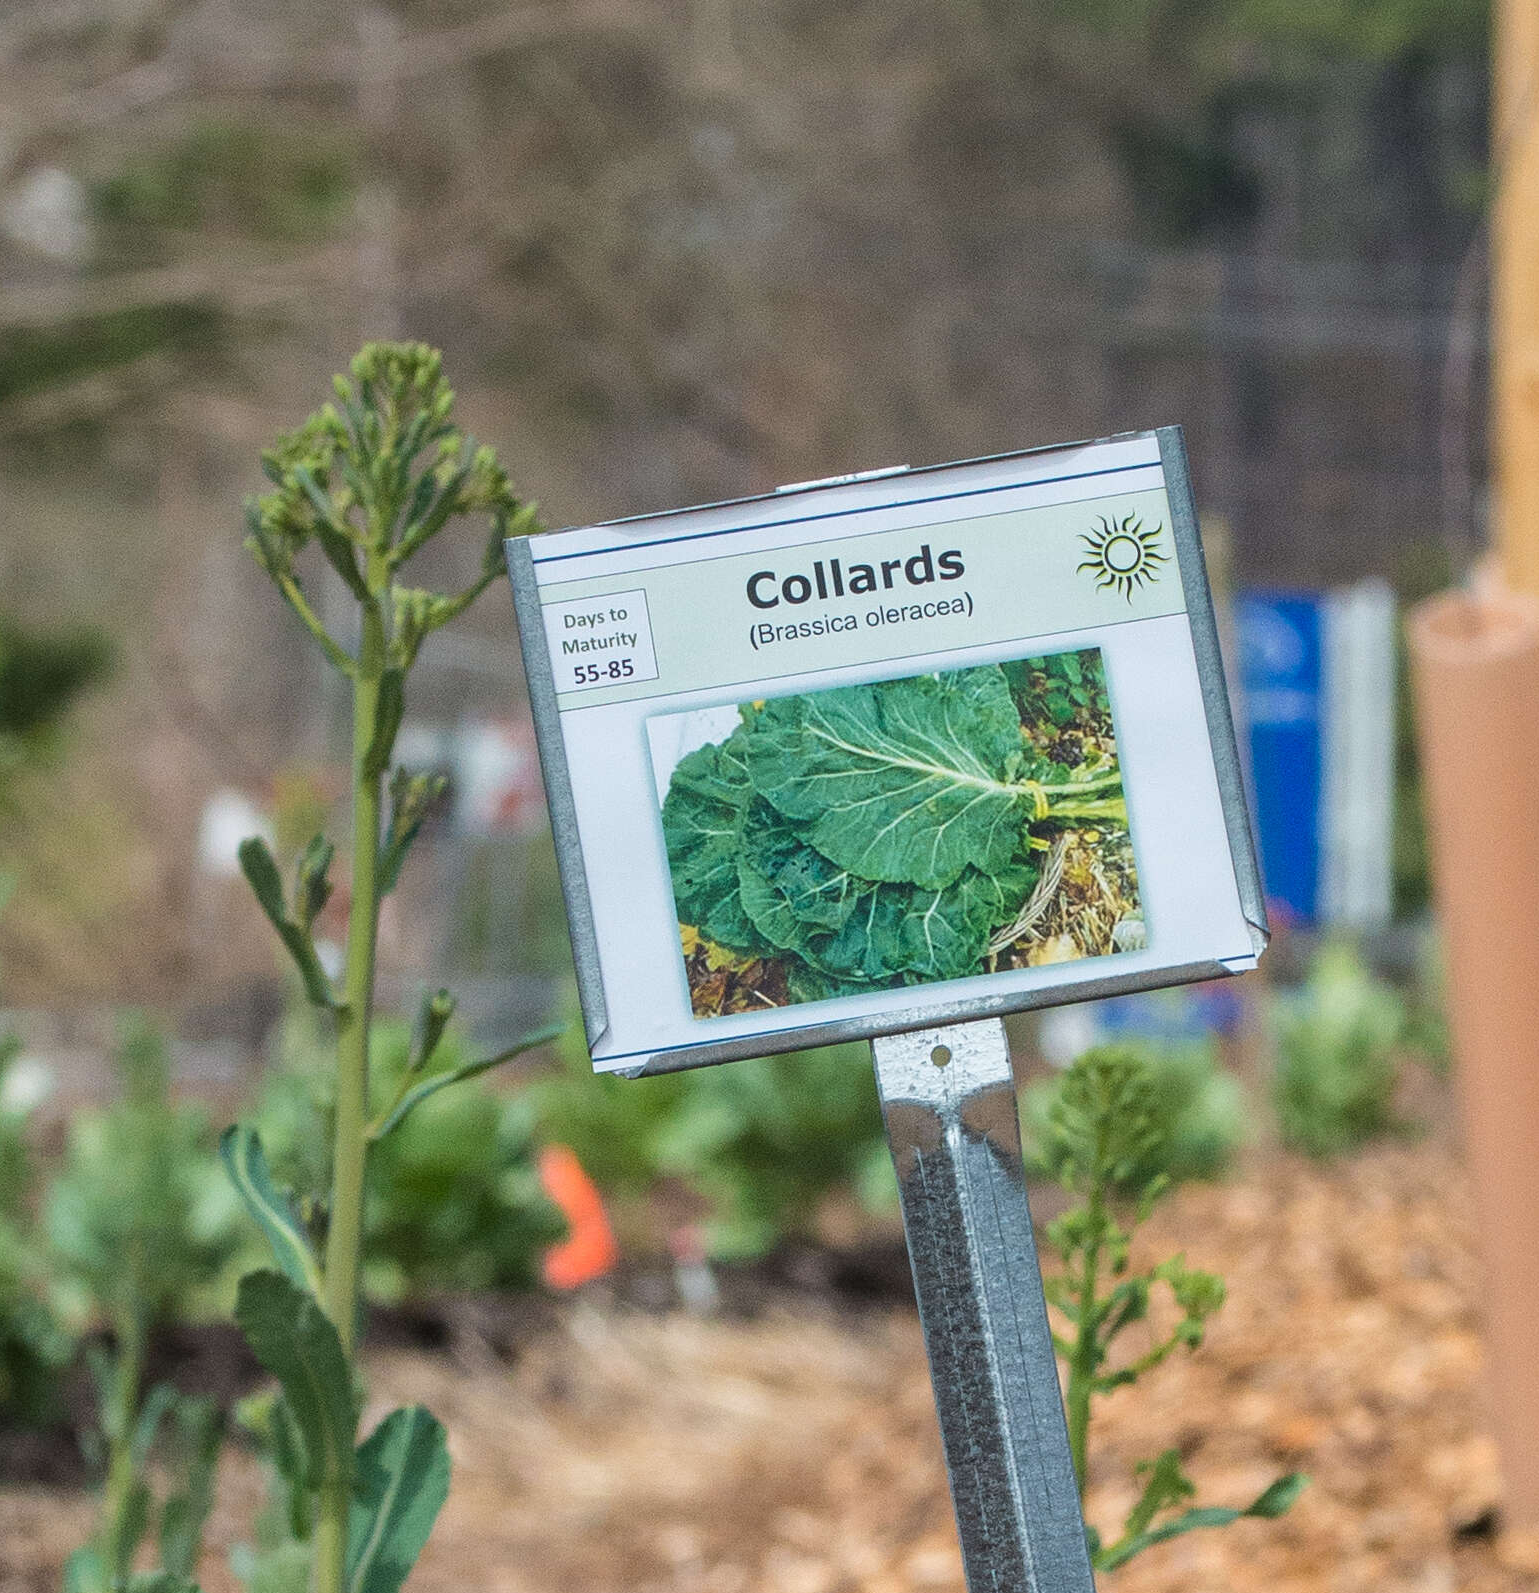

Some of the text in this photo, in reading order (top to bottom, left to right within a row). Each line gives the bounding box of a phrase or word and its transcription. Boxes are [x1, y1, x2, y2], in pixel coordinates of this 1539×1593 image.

[746, 544, 965, 608] Collards
[564, 608, 627, 629] Days to
[750, 592, 973, 650] (Brassica oleracea)
[563, 633, 638, 655] Maturity
[574, 659, 634, 684] 55-85
